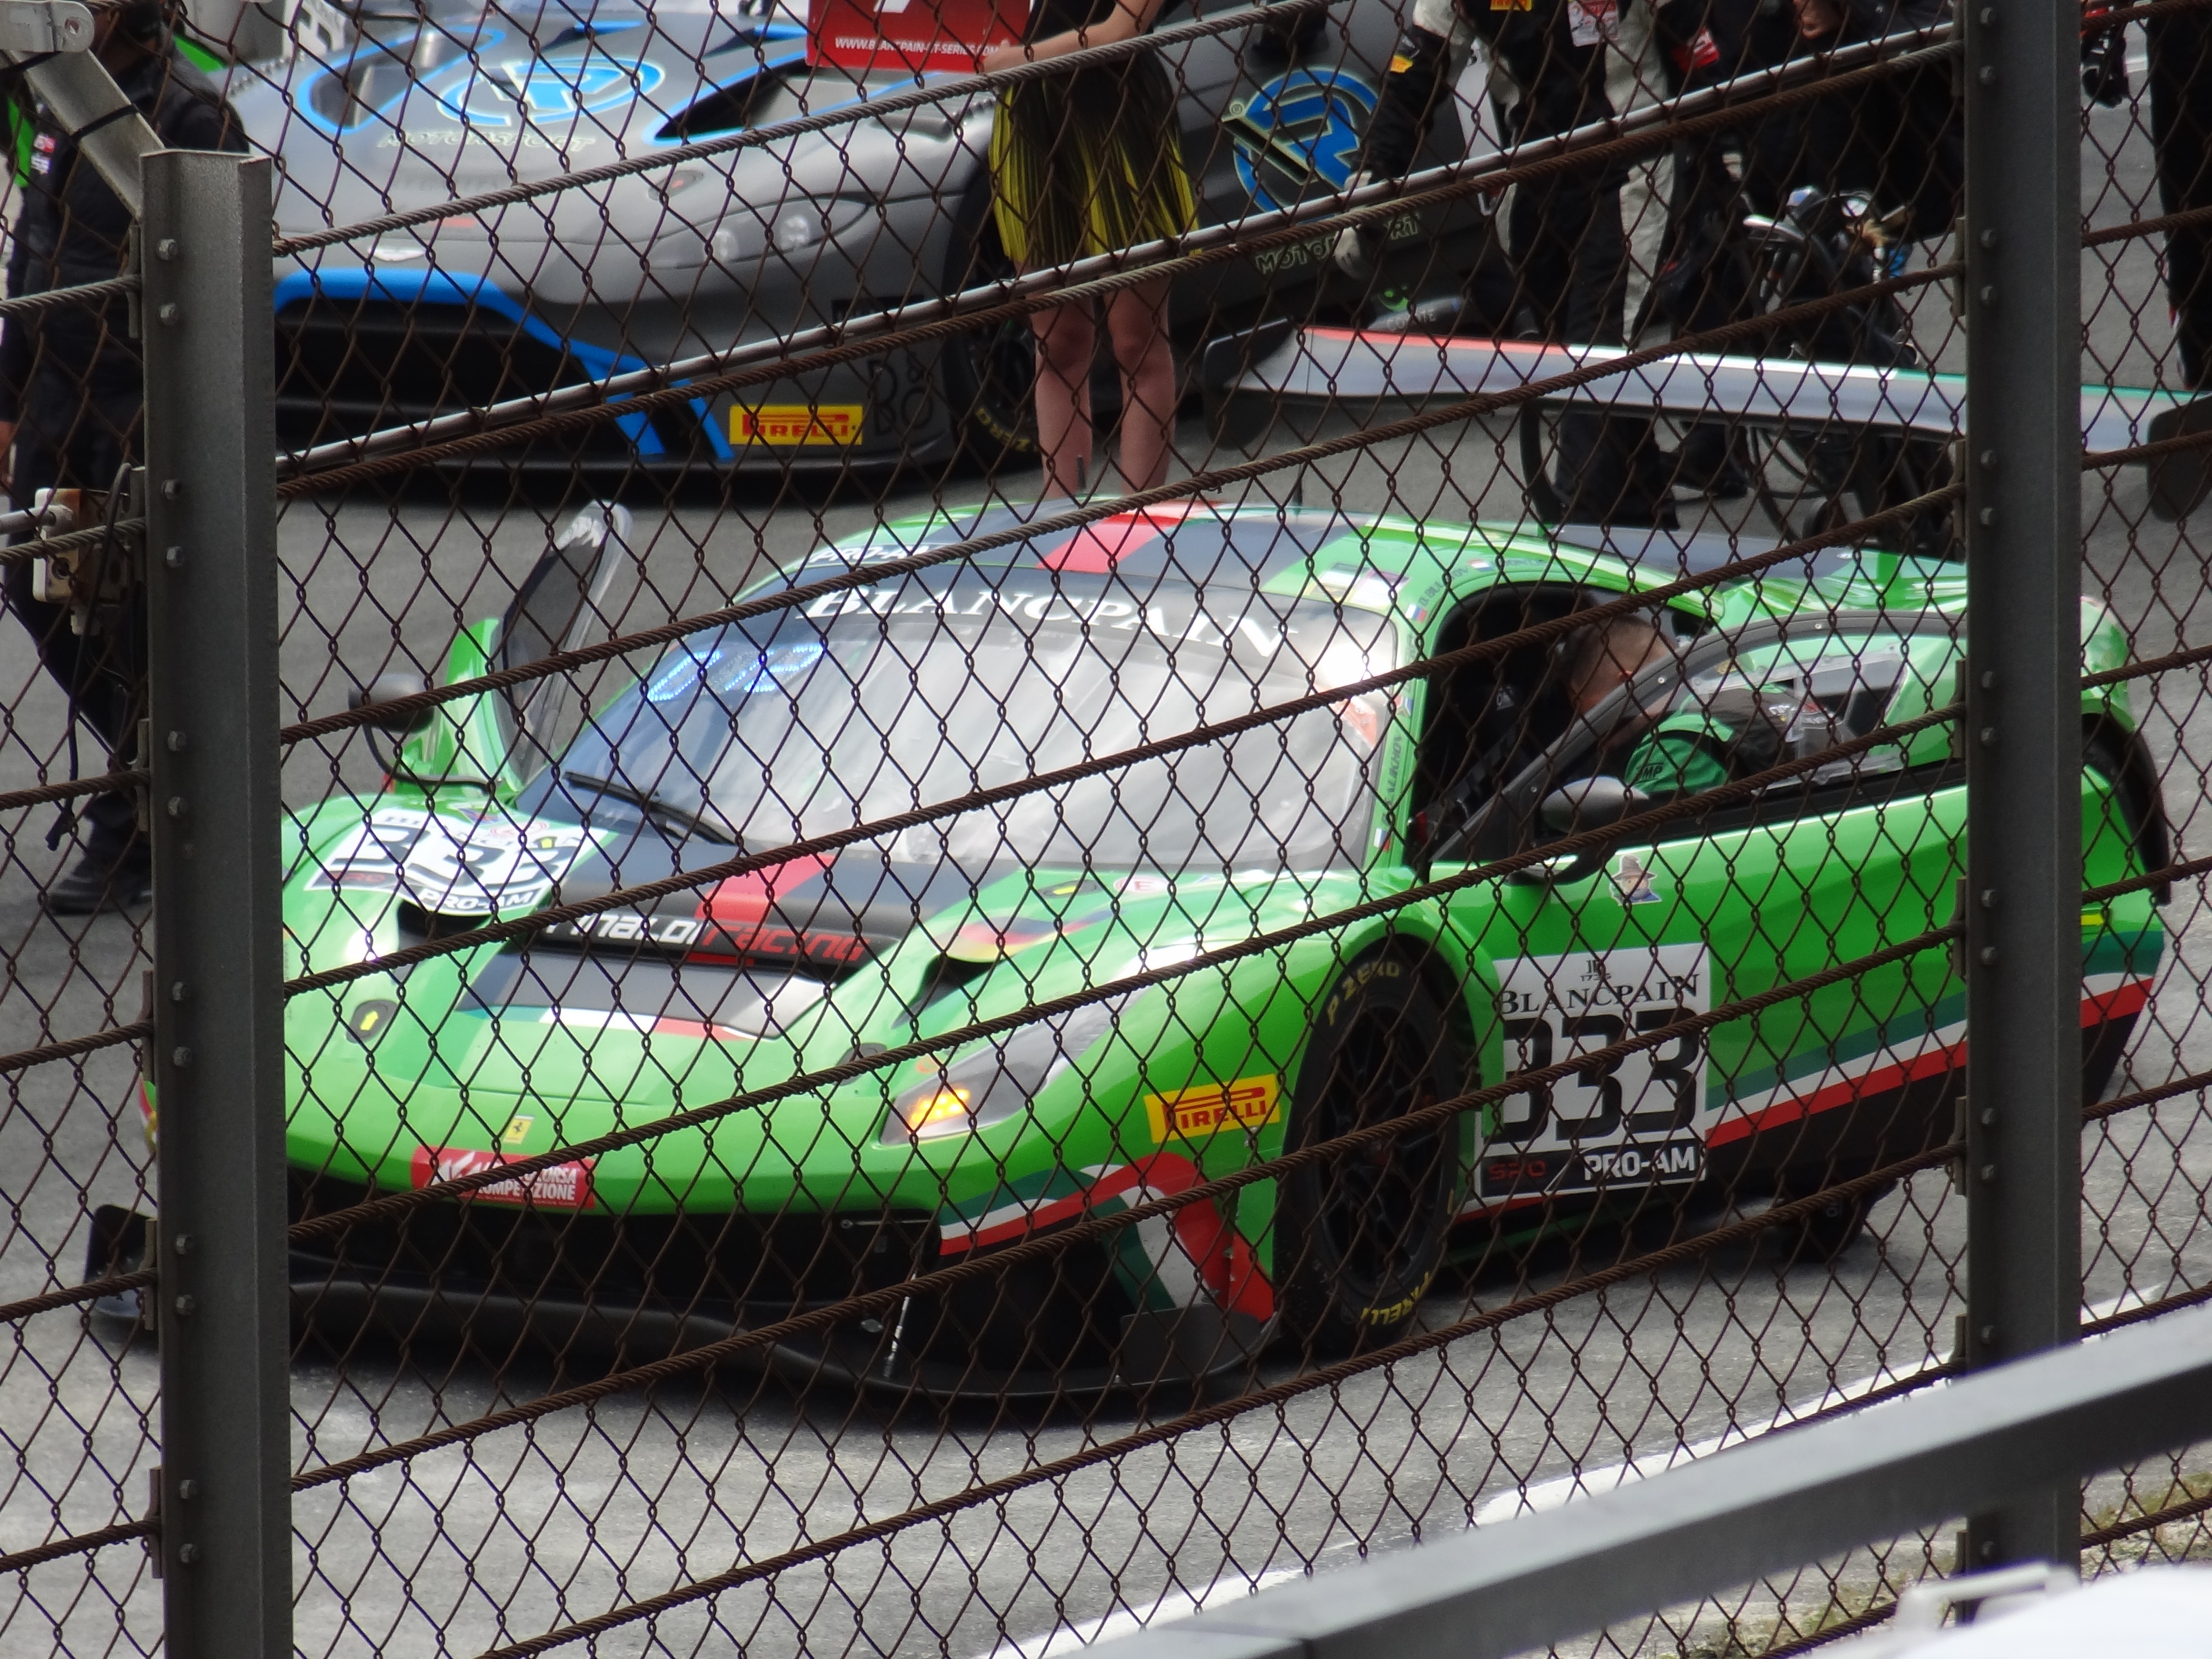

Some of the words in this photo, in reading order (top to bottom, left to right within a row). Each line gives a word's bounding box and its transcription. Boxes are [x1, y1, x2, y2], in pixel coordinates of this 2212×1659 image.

[835, 36, 1000, 58] WWW.BANPAIN-T-SERIES.COM
[1255, 213, 1419, 275] MOTORT
[743, 414, 849, 436] PIRELLI
[795, 587, 1299, 658] BLANCPAIN
[419, 888, 535, 909] PRO-AM
[1500, 973, 1700, 1014] BLANCPAIN
[1483, 1008, 1700, 1145] 333
[1162, 1086, 1266, 1130] PIRELLI
[1584, 1146, 1696, 1181] PRO-AM
[478, 1177, 577, 1201] OMPEZIONE
